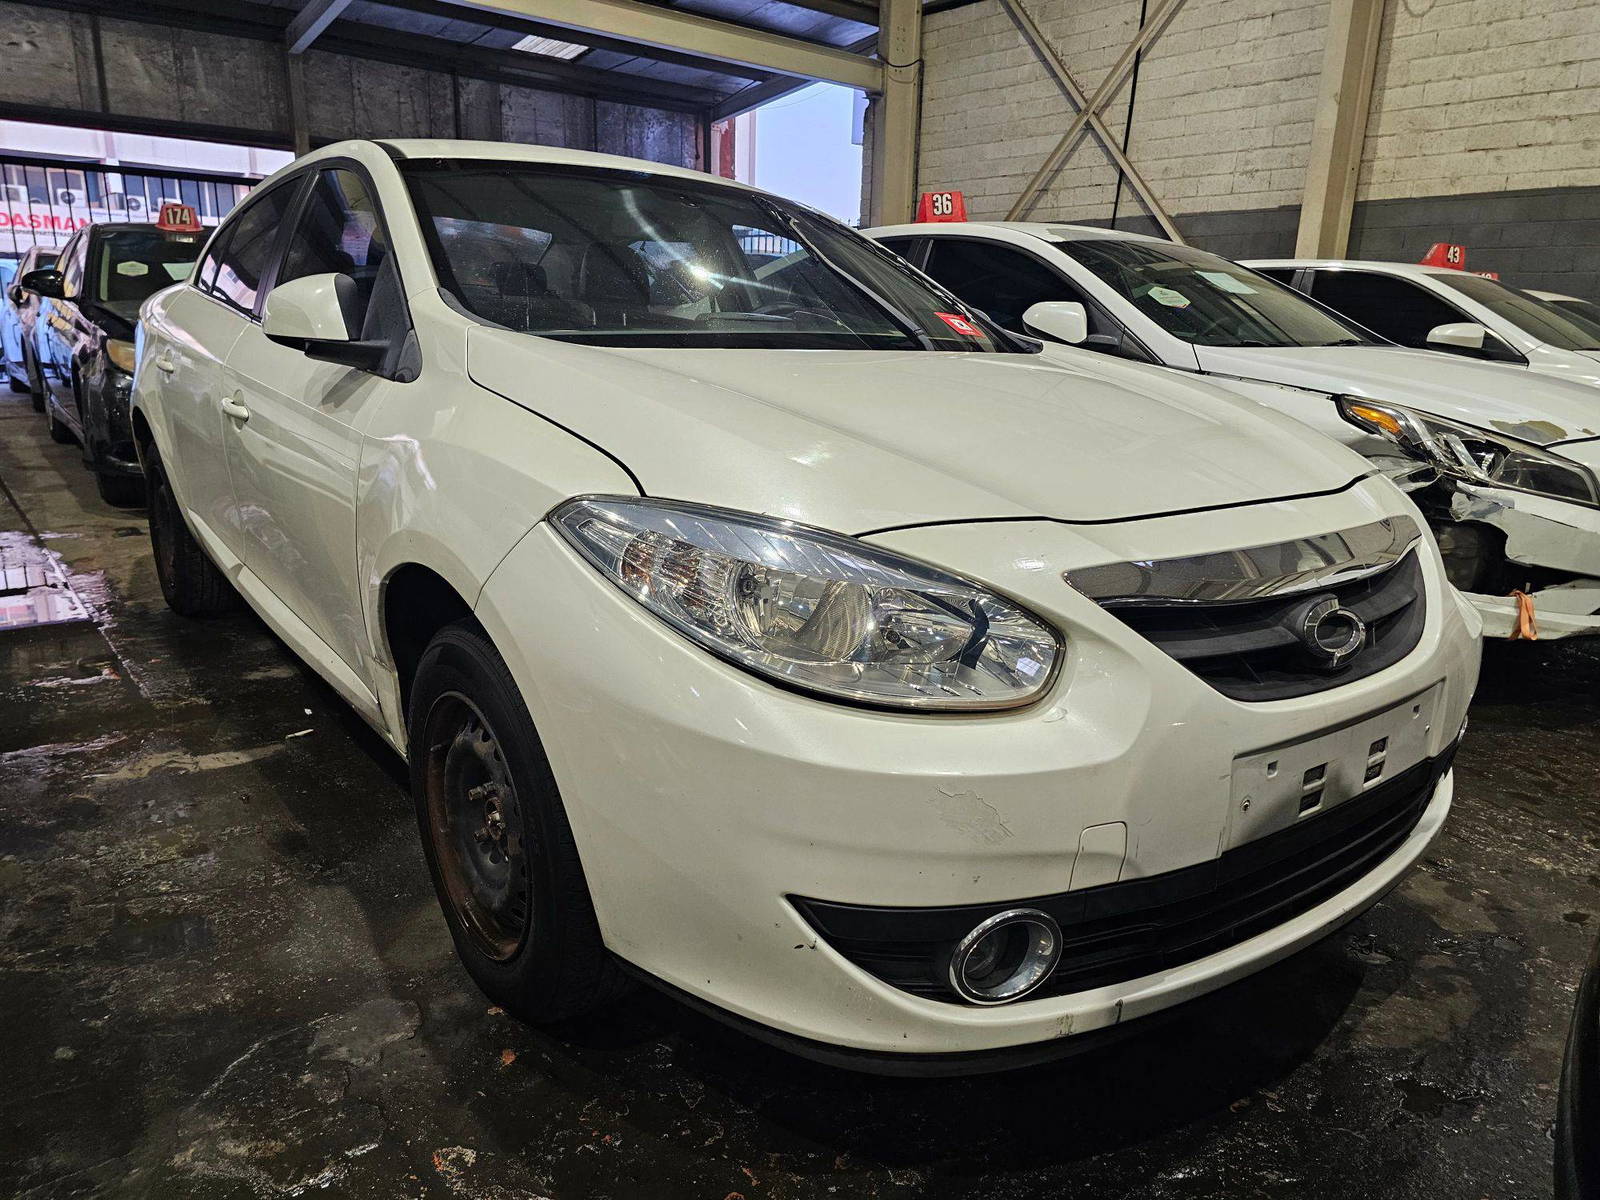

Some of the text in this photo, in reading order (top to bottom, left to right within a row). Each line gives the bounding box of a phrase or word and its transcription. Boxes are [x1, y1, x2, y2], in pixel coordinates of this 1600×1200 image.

[932, 193, 952, 216] 36
[167, 208, 191, 225] 174
[1447, 246, 1460, 263] 43
